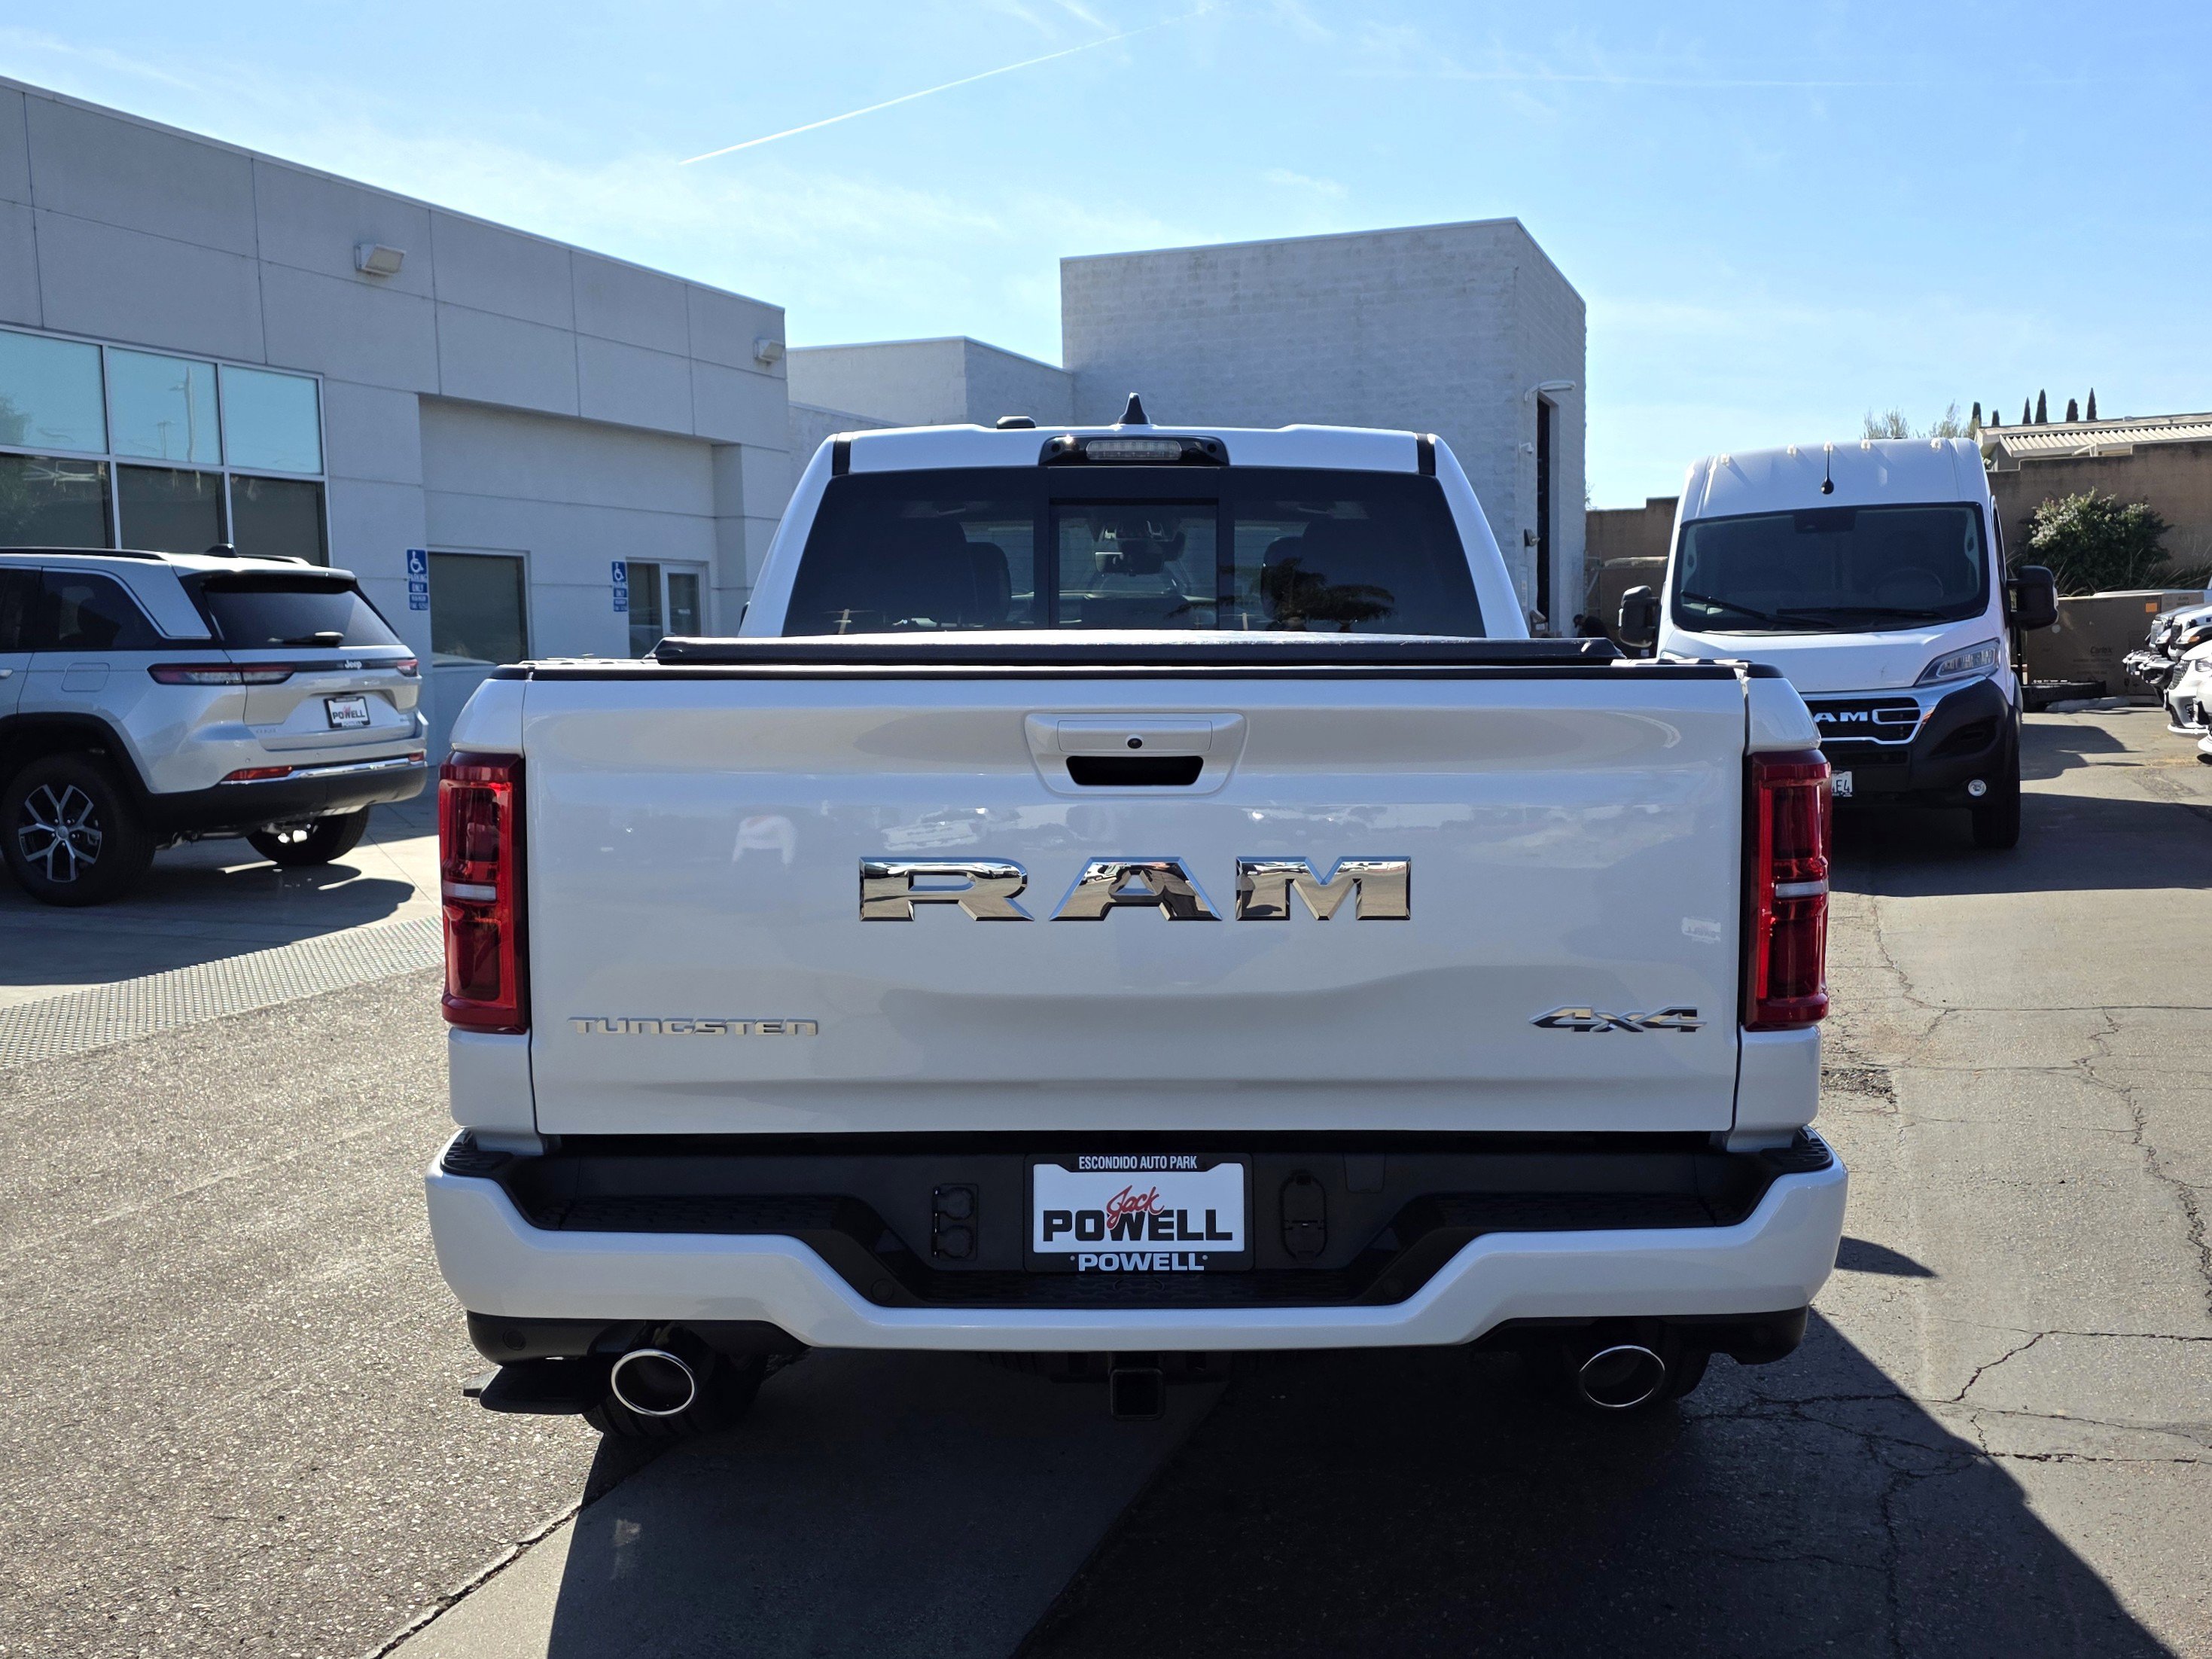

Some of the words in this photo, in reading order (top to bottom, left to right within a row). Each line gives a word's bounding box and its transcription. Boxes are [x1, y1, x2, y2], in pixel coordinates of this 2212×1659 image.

[344, 660, 362, 669] Jeep
[333, 710, 366, 719] POWELL
[1814, 711, 1869, 723] AM
[858, 855, 1412, 922] RAM
[567, 1017, 818, 1035] TUNGSTEN
[1078, 1156, 1138, 1170] ESCONDIDO
[1140, 1156, 1168, 1169] AUTO
[1169, 1155, 1198, 1169] PARK
[1106, 1185, 1165, 1230] Jack
[1043, 1209, 1233, 1242] POWELL
[1078, 1253, 1205, 1272] POWELL
